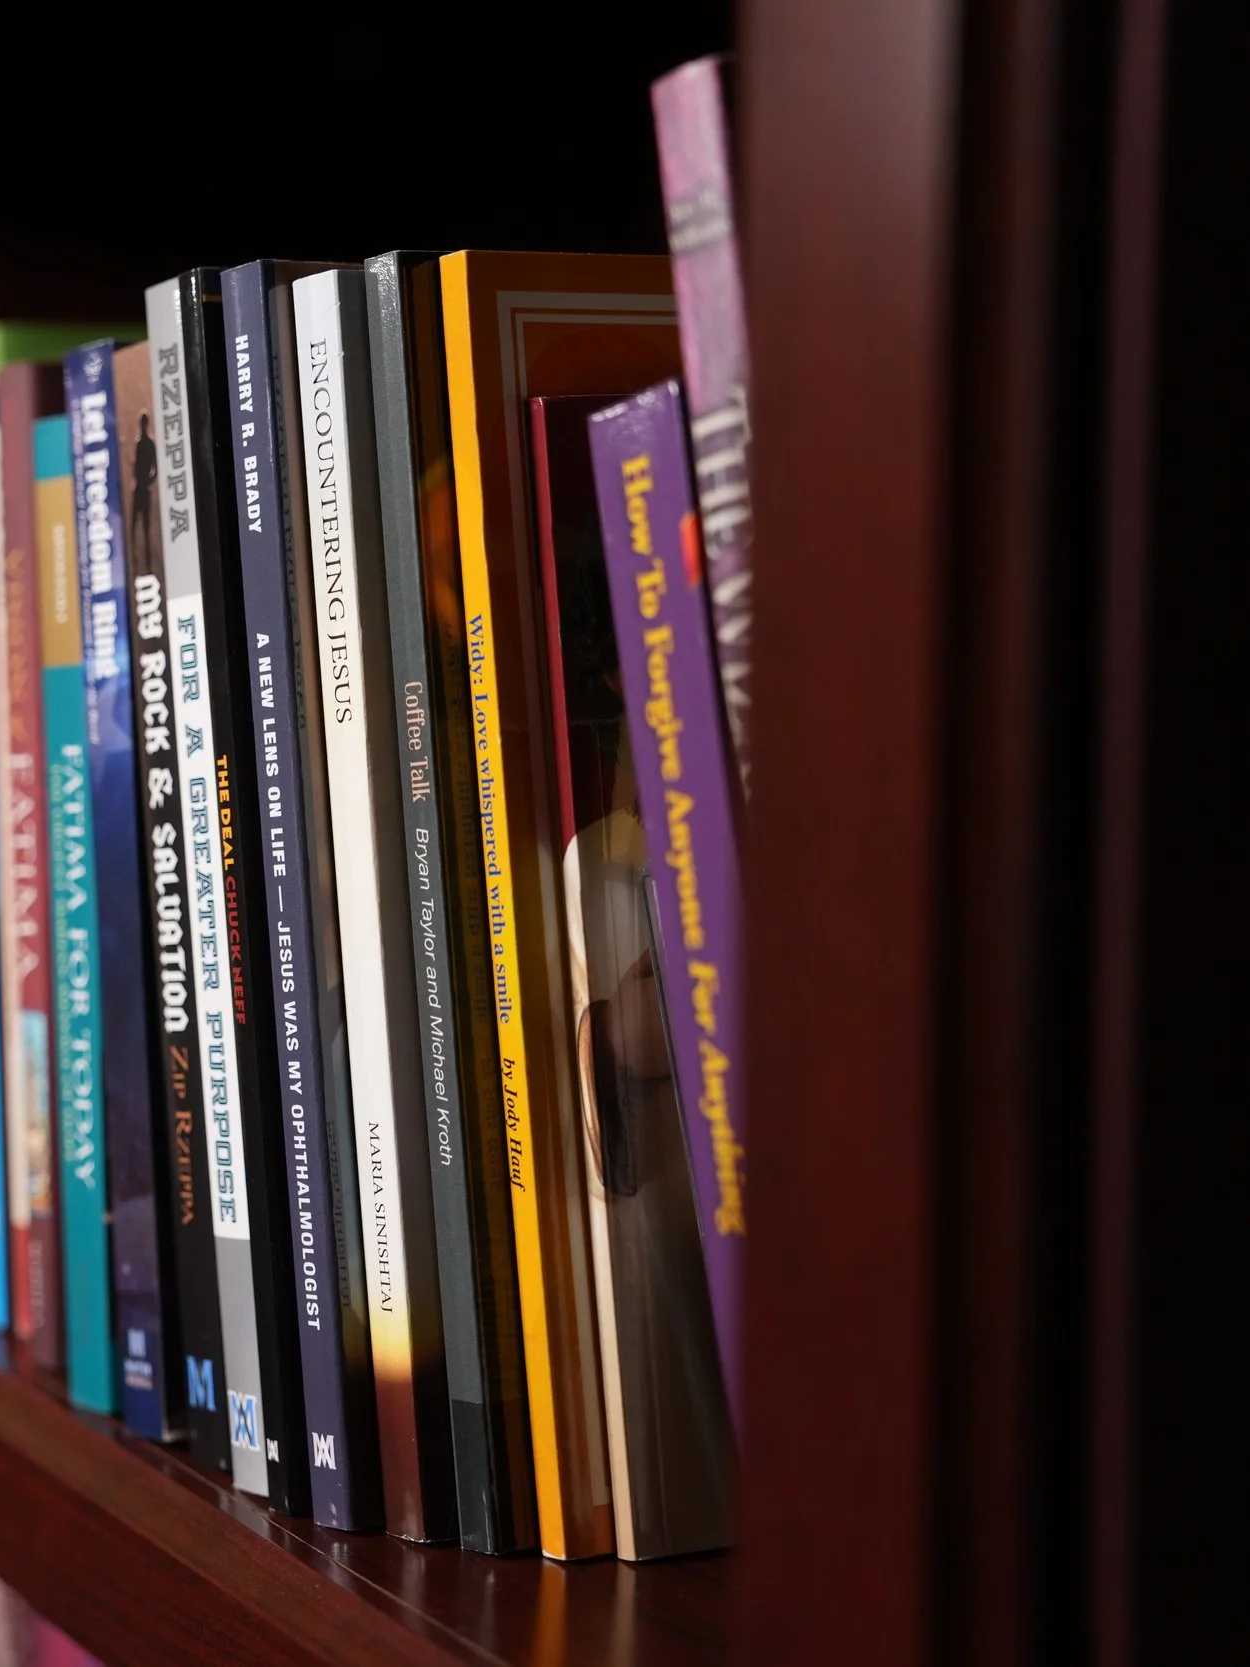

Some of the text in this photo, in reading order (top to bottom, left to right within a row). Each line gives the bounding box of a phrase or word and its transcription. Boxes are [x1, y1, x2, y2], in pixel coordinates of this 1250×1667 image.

[81, 390, 109, 446] Let
[158, 342, 190, 543] RZEPPA
[235, 334, 263, 534] HARRY R. BRADY
[82, 448, 113, 595] Freedom
[309, 337, 354, 725] ENCOUNTERING JESUS
[91, 599, 120, 681] Ring
[256, 633, 270, 649] A
[258, 656, 275, 708] NEW
[468, 613, 485, 685] Widy:
[139, 648, 171, 756] ROCK
[262, 717, 279, 777] LENS
[404, 681, 431, 803] Coffee Talk
[474, 692, 489, 751] Love
[61, 744, 88, 913] FATIMA
[149, 767, 174, 809] &
[216, 753, 235, 872] THE DEAL
[267, 786, 282, 818] ON
[480, 757, 502, 877] whispered
[270, 827, 287, 877] LIFE
[621, 453, 747, 1238] How To Forgive Anyone For Anything
[178, 614, 237, 1224] FOR A GREATER PURPOSE
[225, 875, 246, 1026] CHUCK NEFF
[277, 921, 295, 993] JESUS
[490, 884, 506, 936] with
[494, 942, 504, 956] a
[67, 927, 91, 1018] FOR
[415, 827, 453, 1166] Bryan Taylor and Michael Kroth
[496, 963, 512, 1025] smile
[283, 1000, 299, 1052] WAS
[71, 1027, 96, 1190] TODAY
[288, 1061, 303, 1095] MY
[501, 1057, 526, 1192] by Jody Hauf
[291, 1104, 321, 1331] OPHTHALMOLOGIST
[368, 1121, 393, 1313] MARIA SINISHTAJ
